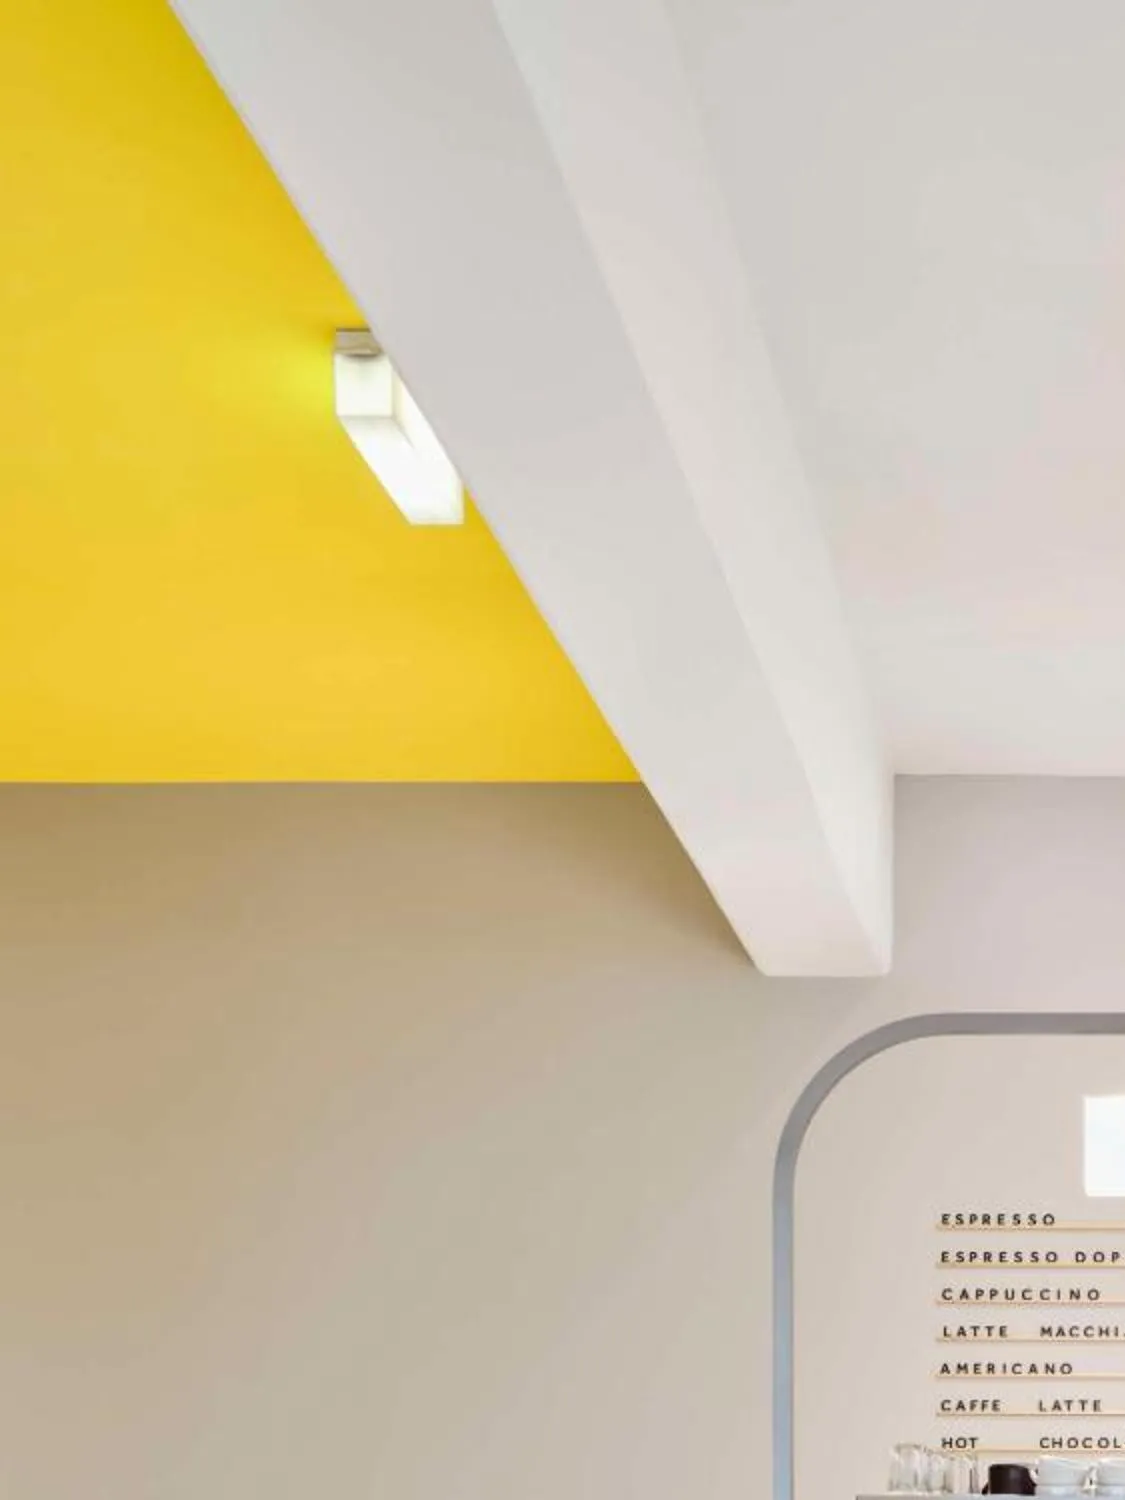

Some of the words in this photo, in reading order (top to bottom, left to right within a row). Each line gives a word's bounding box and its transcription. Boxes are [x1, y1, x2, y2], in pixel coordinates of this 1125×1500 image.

[941, 1213, 1055, 1226] ESPRESSO
[940, 1250, 1058, 1263] ESPRESSO
[941, 1287, 1100, 1301] CAPPUCCINO
[943, 1325, 1007, 1338] LATTE
[939, 1362, 1073, 1375] AMERICANO
[940, 1399, 1000, 1412] CAFFE
[1039, 1399, 1101, 1412] LATTE
[941, 1436, 978, 1449] HOT
